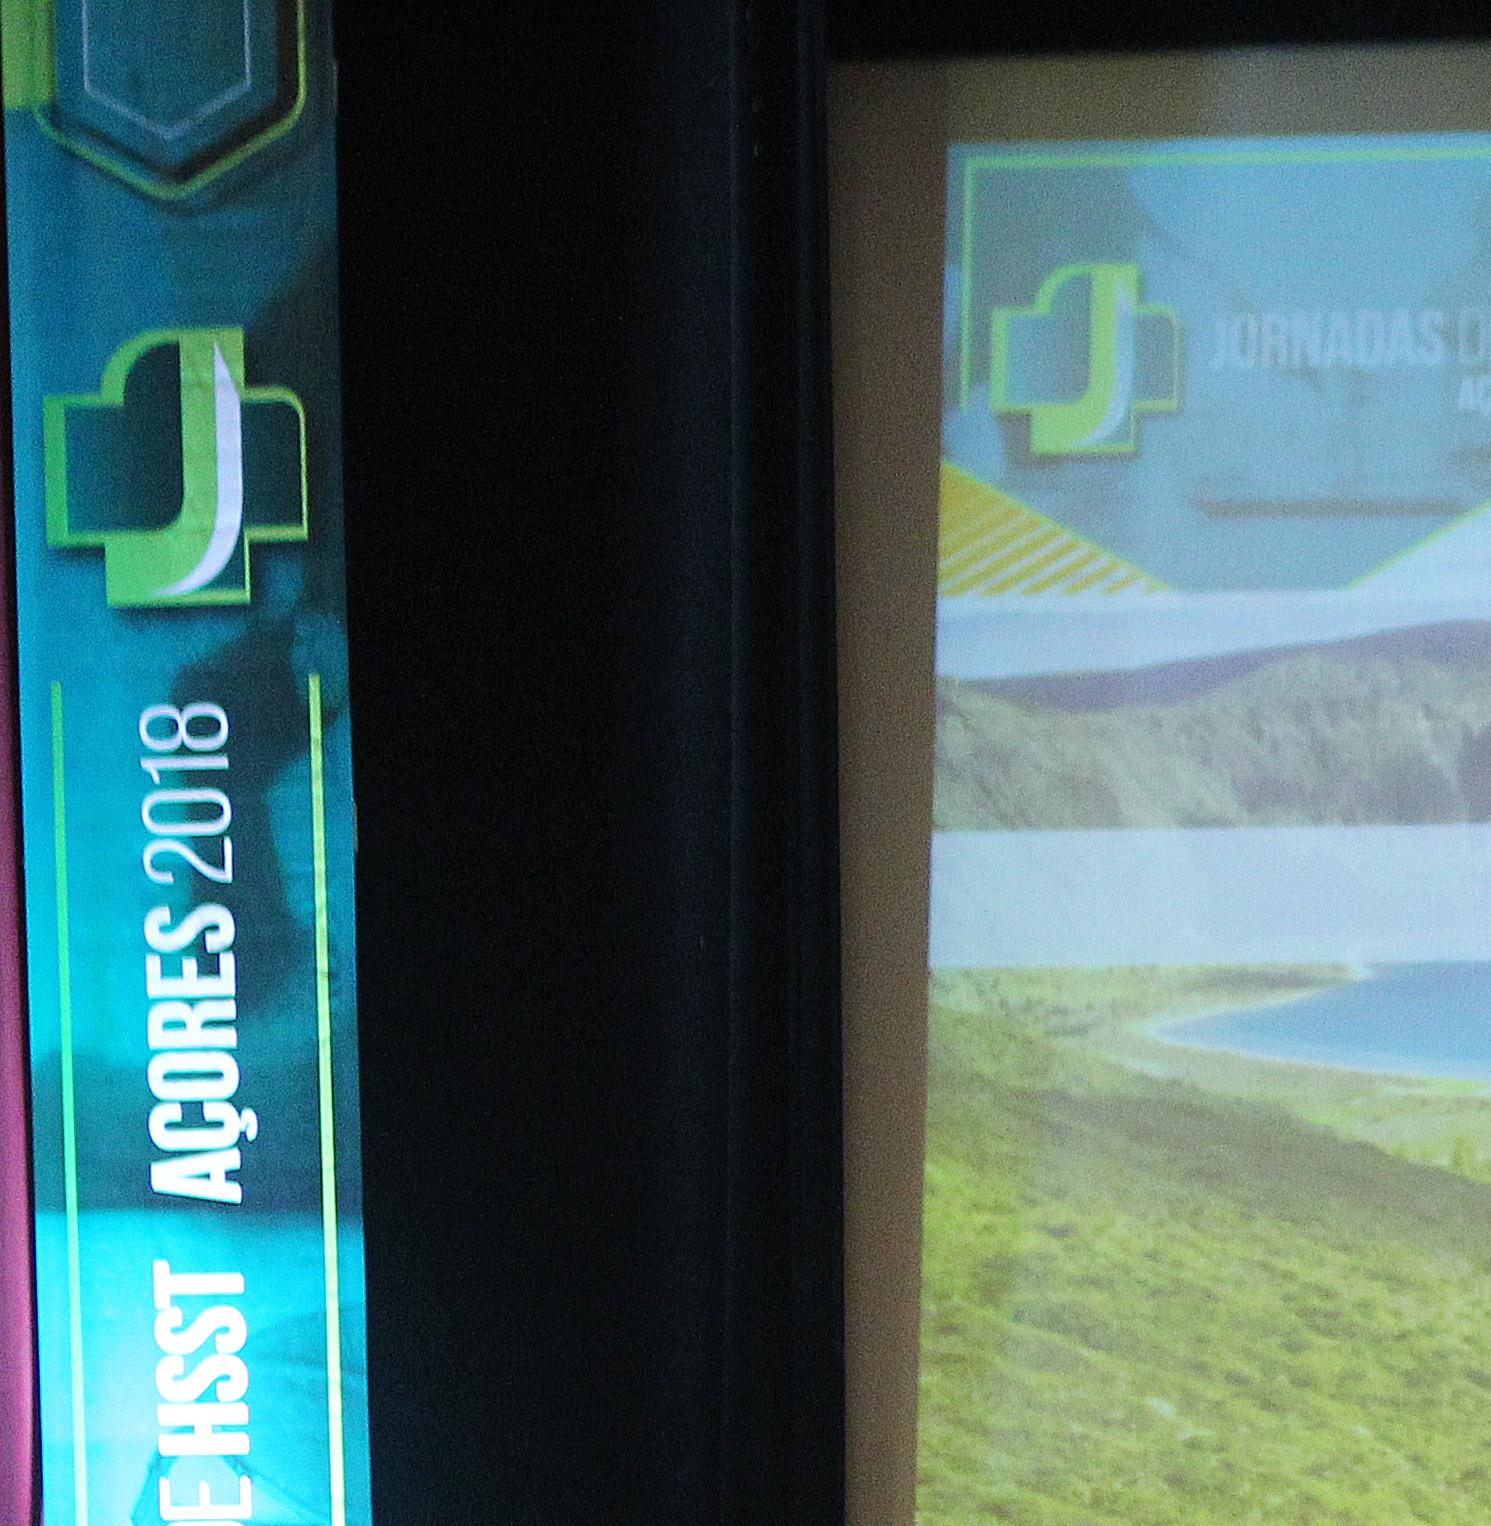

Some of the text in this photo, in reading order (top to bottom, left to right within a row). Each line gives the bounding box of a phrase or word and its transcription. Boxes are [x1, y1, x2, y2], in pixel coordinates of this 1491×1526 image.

[138, 698, 232, 884] 2018
[145, 904, 258, 1205] AÇORES
[152, 1259, 249, 1461] HSST
